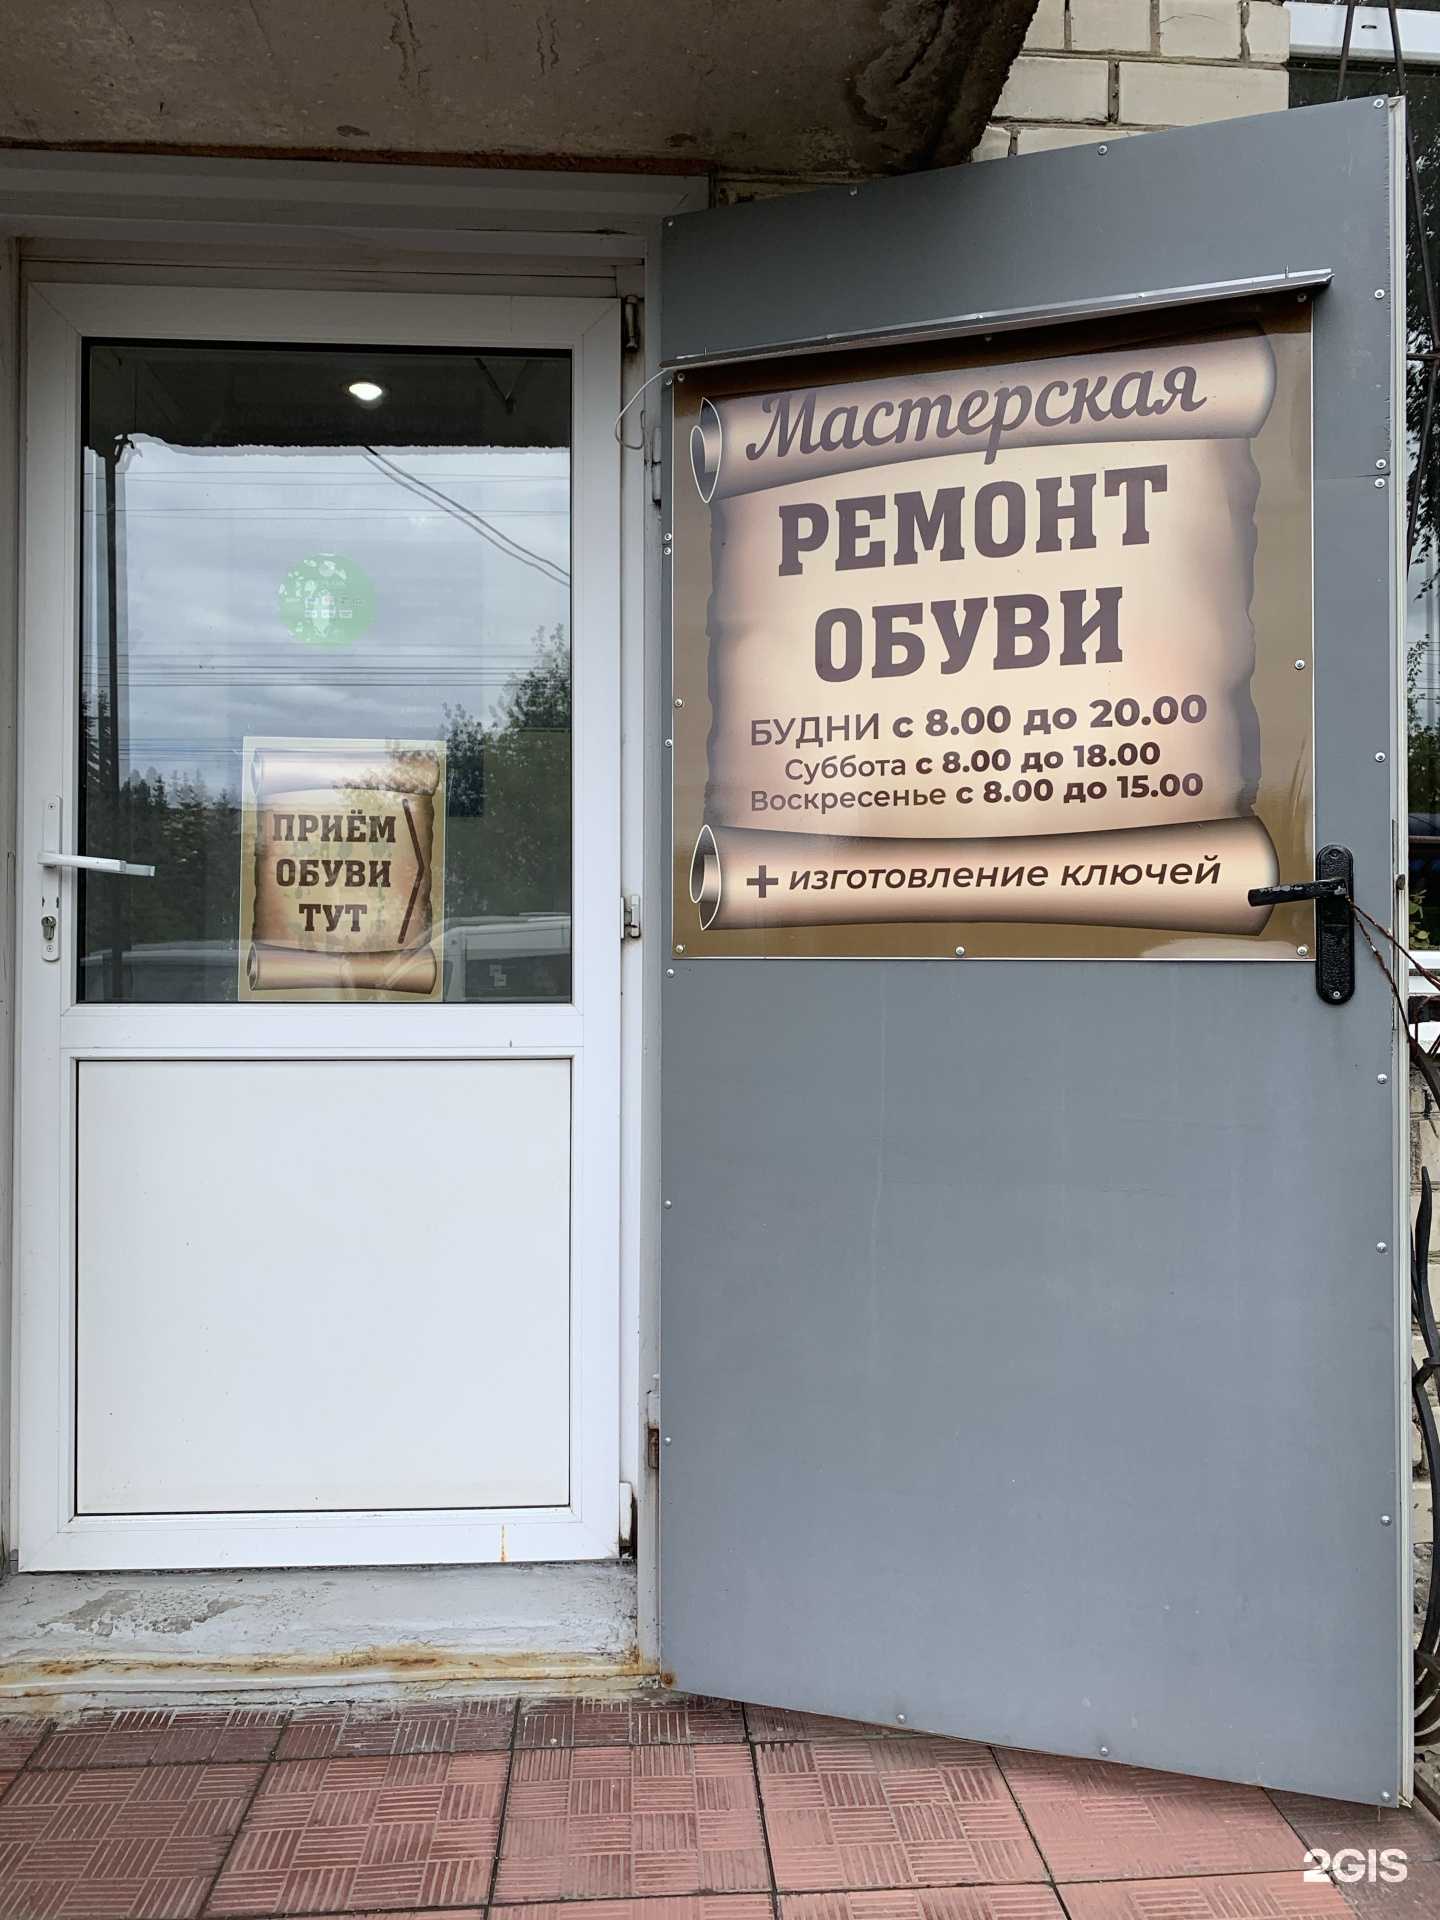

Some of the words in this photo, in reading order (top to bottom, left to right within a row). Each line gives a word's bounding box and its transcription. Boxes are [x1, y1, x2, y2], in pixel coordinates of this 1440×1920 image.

[745, 365, 1207, 465] Мастерская
[778, 464, 1168, 577] РЕМОНТ
[815, 586, 1124, 683] ОБУВИ
[750, 712, 880, 749] БУДНИ
[892, 716, 914, 739] с
[925, 703, 1012, 737] 8.00
[1023, 704, 1077, 735] до
[1089, 694, 1208, 729] 20.00
[784, 755, 906, 785] Суббота
[915, 754, 934, 776] с
[942, 747, 1012, 774] 8.00
[1020, 749, 1065, 773] до
[1073, 741, 1161, 769] 18.00
[750, 785, 947, 816] Воскресенье
[955, 784, 974, 805] с
[983, 778, 1054, 804] 8.00
[1063, 780, 1108, 805] до
[1117, 772, 1204, 799] 15.00
[272, 809, 397, 843] ПРИЁМ
[275, 858, 392, 888] ОБУВИ
[788, 862, 1049, 893] изготовление
[1060, 855, 1222, 888] ключей
[298, 903, 368, 932] ТУТ
